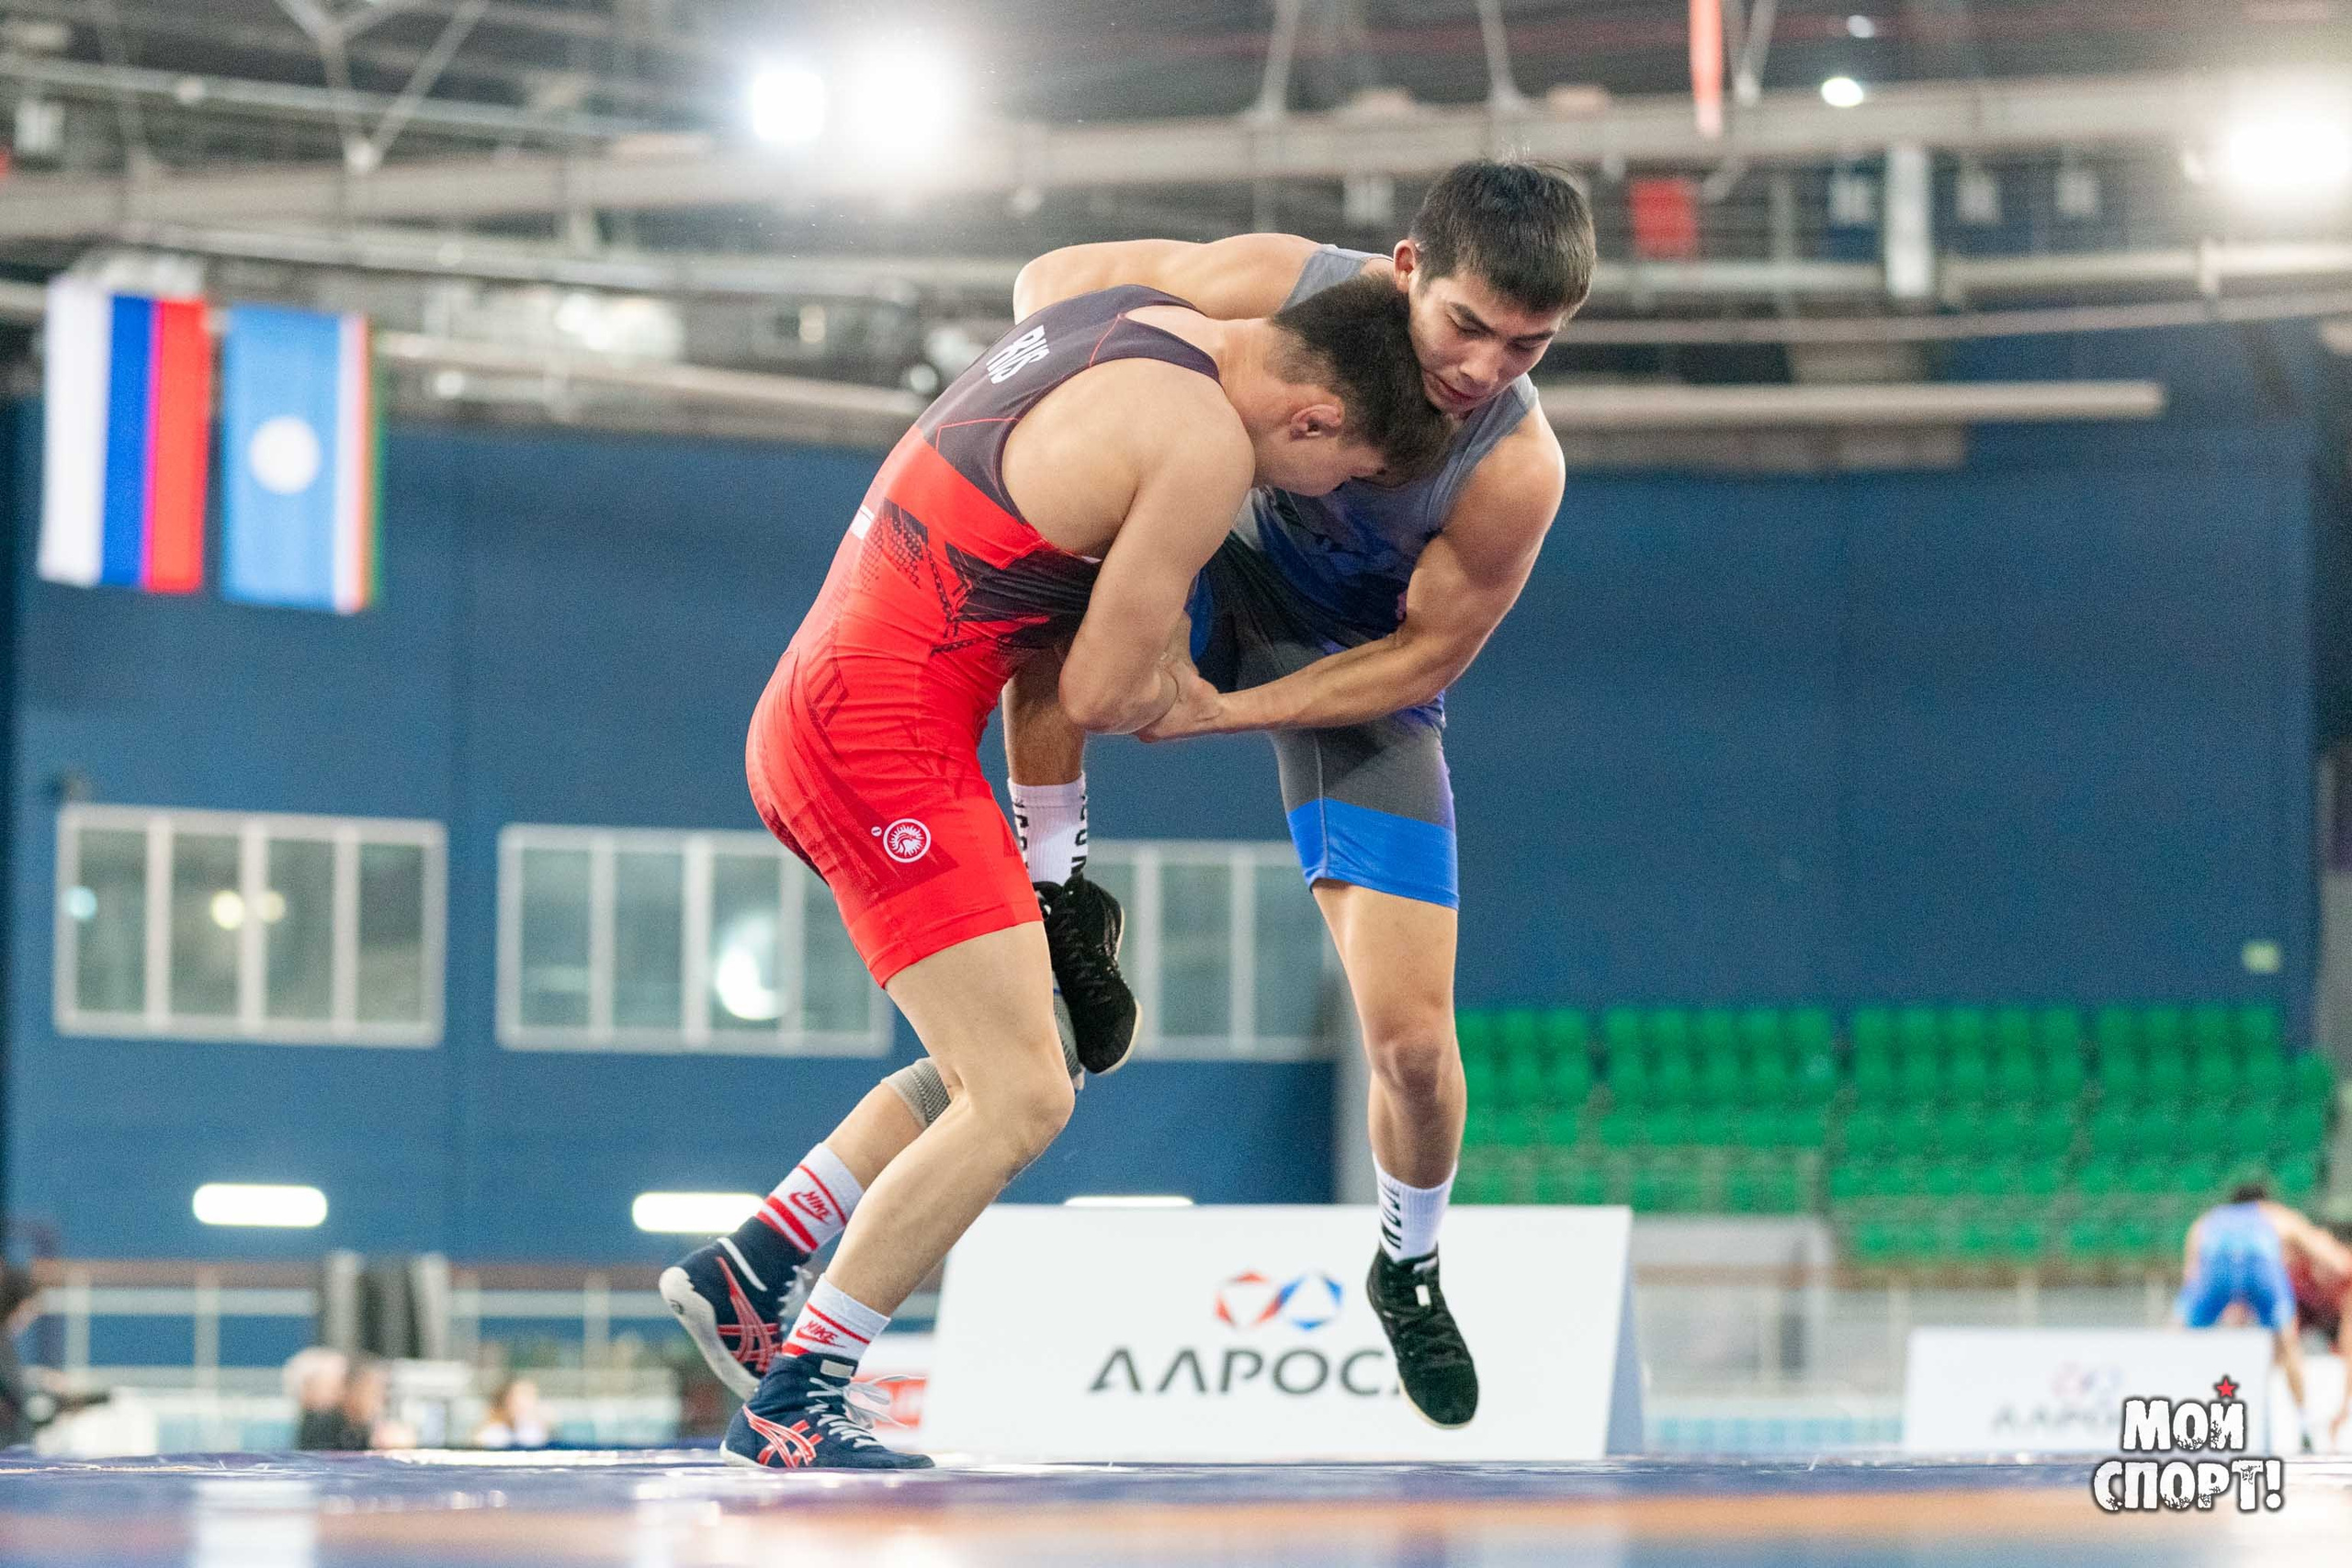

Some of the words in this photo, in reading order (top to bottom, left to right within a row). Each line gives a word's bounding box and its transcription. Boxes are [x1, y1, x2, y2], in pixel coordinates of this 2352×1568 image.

[987, 325, 1049, 384] RUS
[802, 1191, 831, 1218] NIKE
[803, 1320, 839, 1341] NIKE
[1088, 1347, 1399, 1395] АЛРОС
